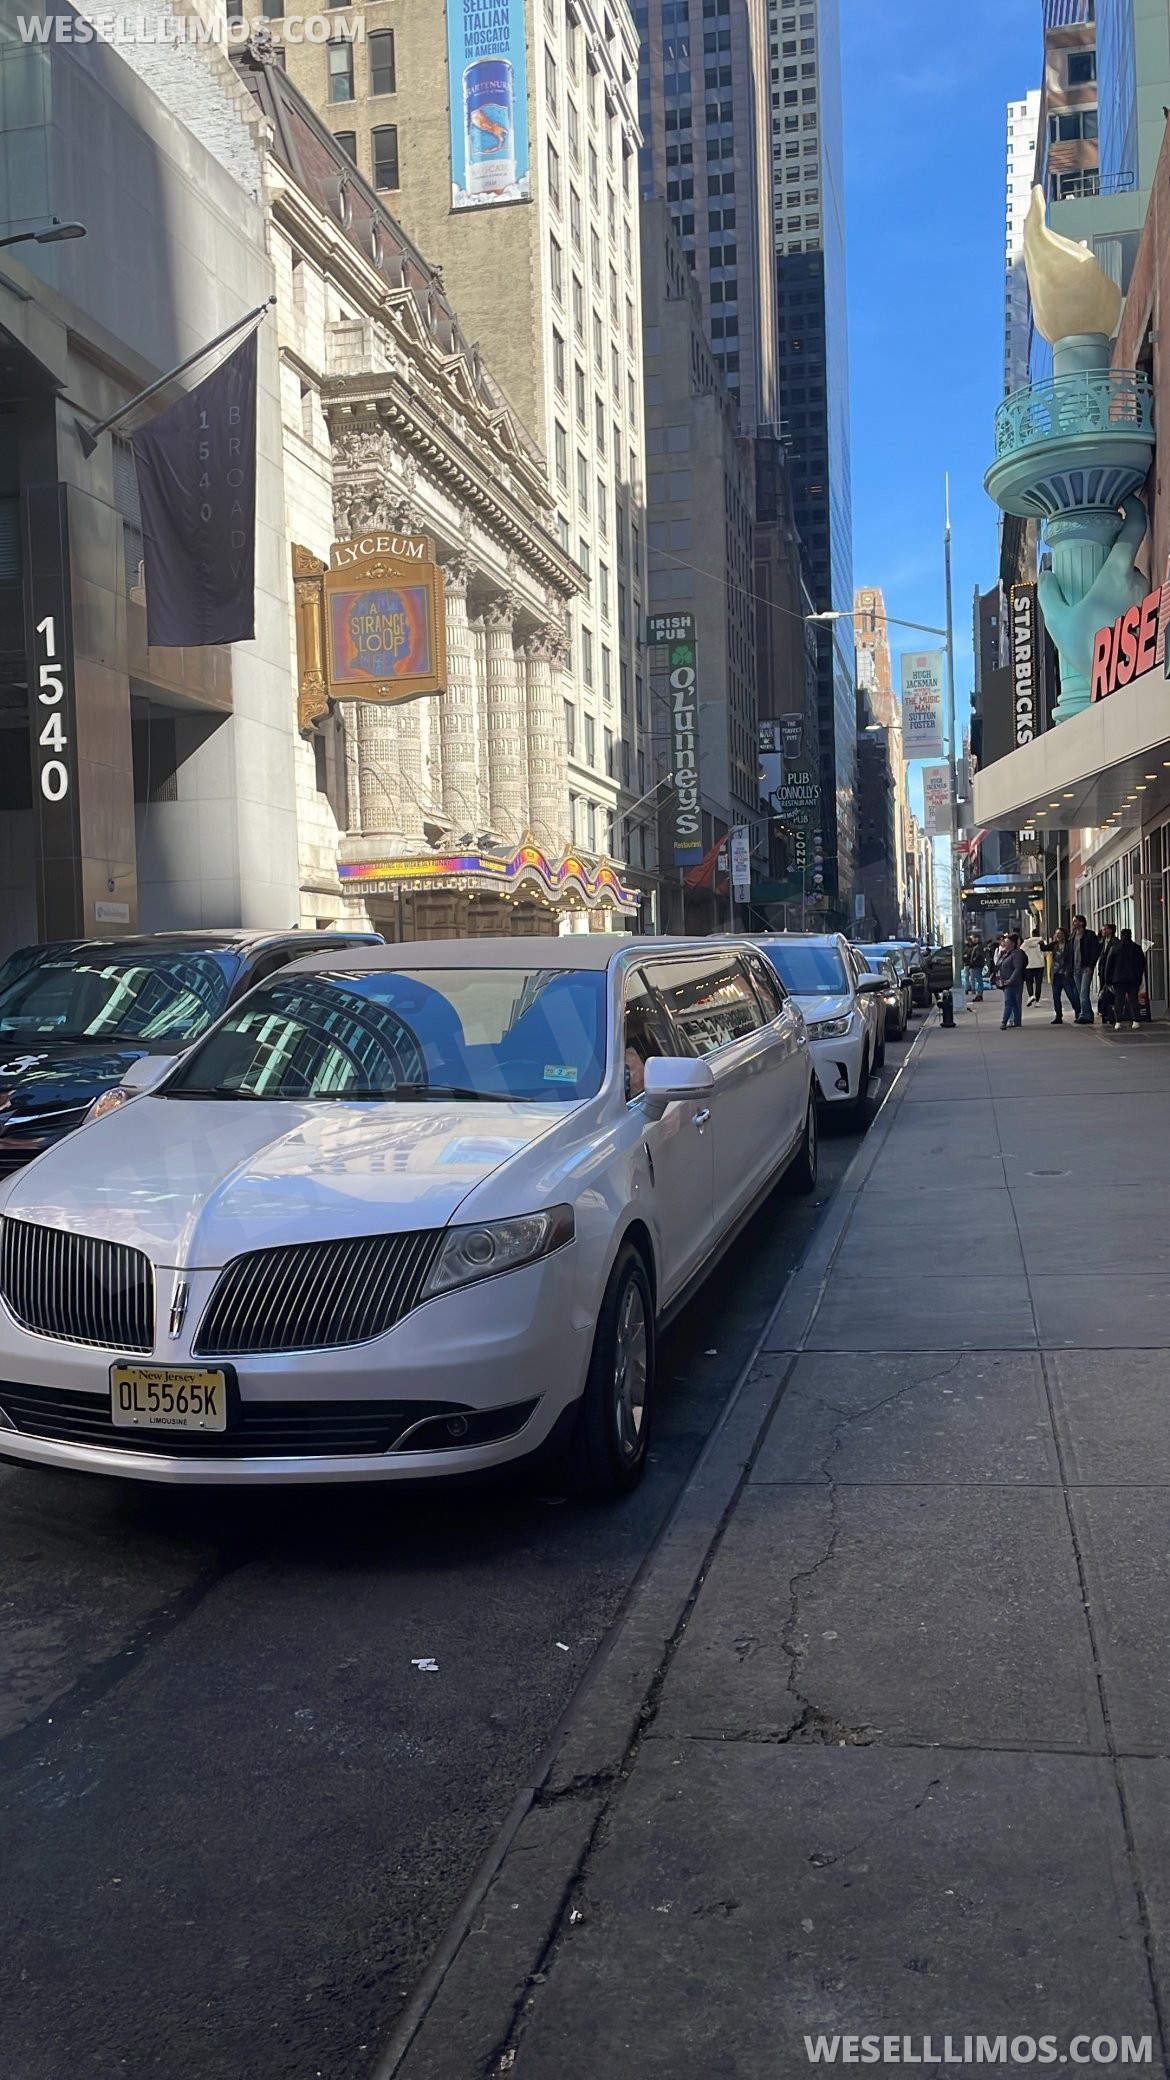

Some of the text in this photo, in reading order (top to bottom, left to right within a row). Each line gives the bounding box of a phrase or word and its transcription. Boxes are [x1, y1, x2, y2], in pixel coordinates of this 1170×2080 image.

[463, 0, 509, 13] SELLING
[463, 8, 510, 31] ITALIAN
[464, 26, 510, 47] MOSCATO
[465, 41, 510, 58] IN AMERICA
[199, 410, 212, 521] 1540
[335, 536, 425, 566] LYCEUM
[369, 603, 378, 615] A
[351, 612, 405, 636] STRANGE
[650, 616, 691, 630] IRISH
[656, 628, 686, 640] PUB
[359, 628, 405, 657] LOOP
[912, 670, 932, 680] HUGH
[1013, 596, 1034, 745] STARBUCKS
[906, 678, 938, 689] JACKMAN
[905, 695, 940, 705] THE MUSIC
[36, 616, 69, 802] 1540
[914, 703, 931, 712] MAN
[909, 711, 936, 721] SUTTON
[909, 719, 936, 730] FOSTER
[788, 772, 810, 785] PUB
[776, 785, 822, 800] CONNOLLY'S
[793, 815, 809, 824] PUB
[138, 1369, 196, 1383] New Jersey
[149, 1416, 188, 1426] LIMOUSINE
